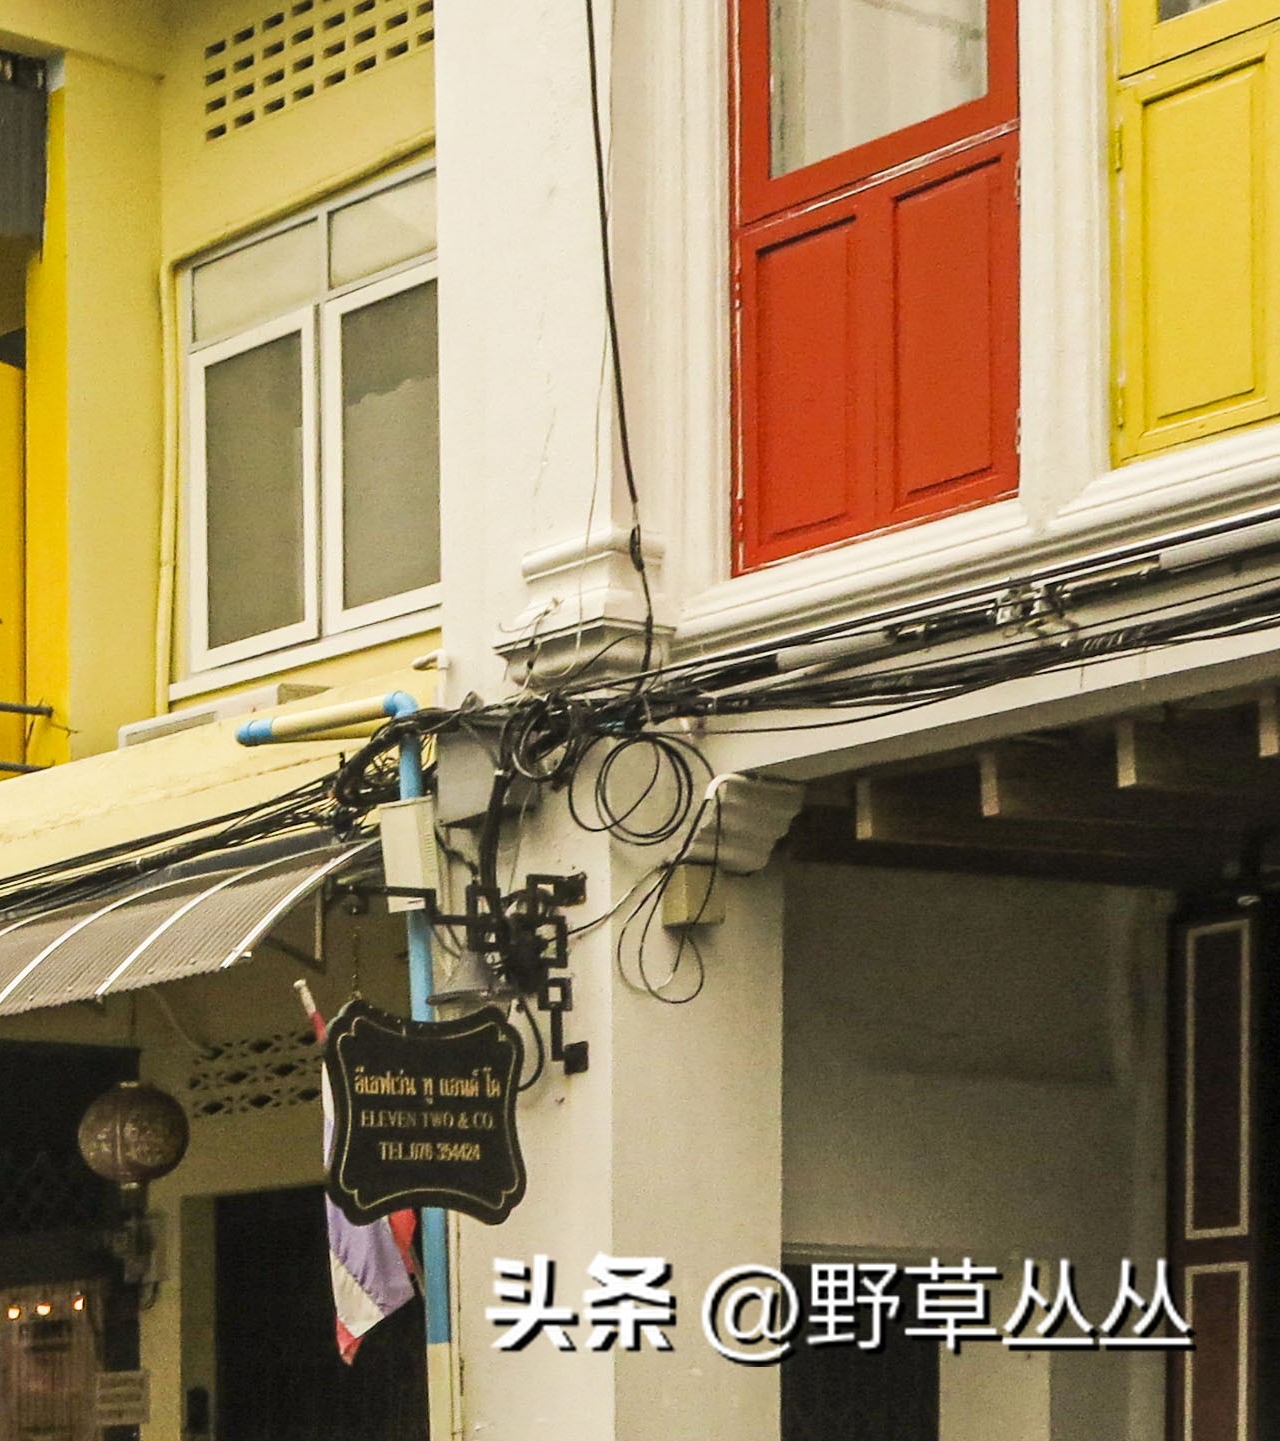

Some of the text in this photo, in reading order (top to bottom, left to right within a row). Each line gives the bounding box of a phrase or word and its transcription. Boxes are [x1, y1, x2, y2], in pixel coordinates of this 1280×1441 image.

[361, 1110, 416, 1128] ELEVEN
[422, 1111, 455, 1128] TWO
[458, 1111, 469, 1129] &
